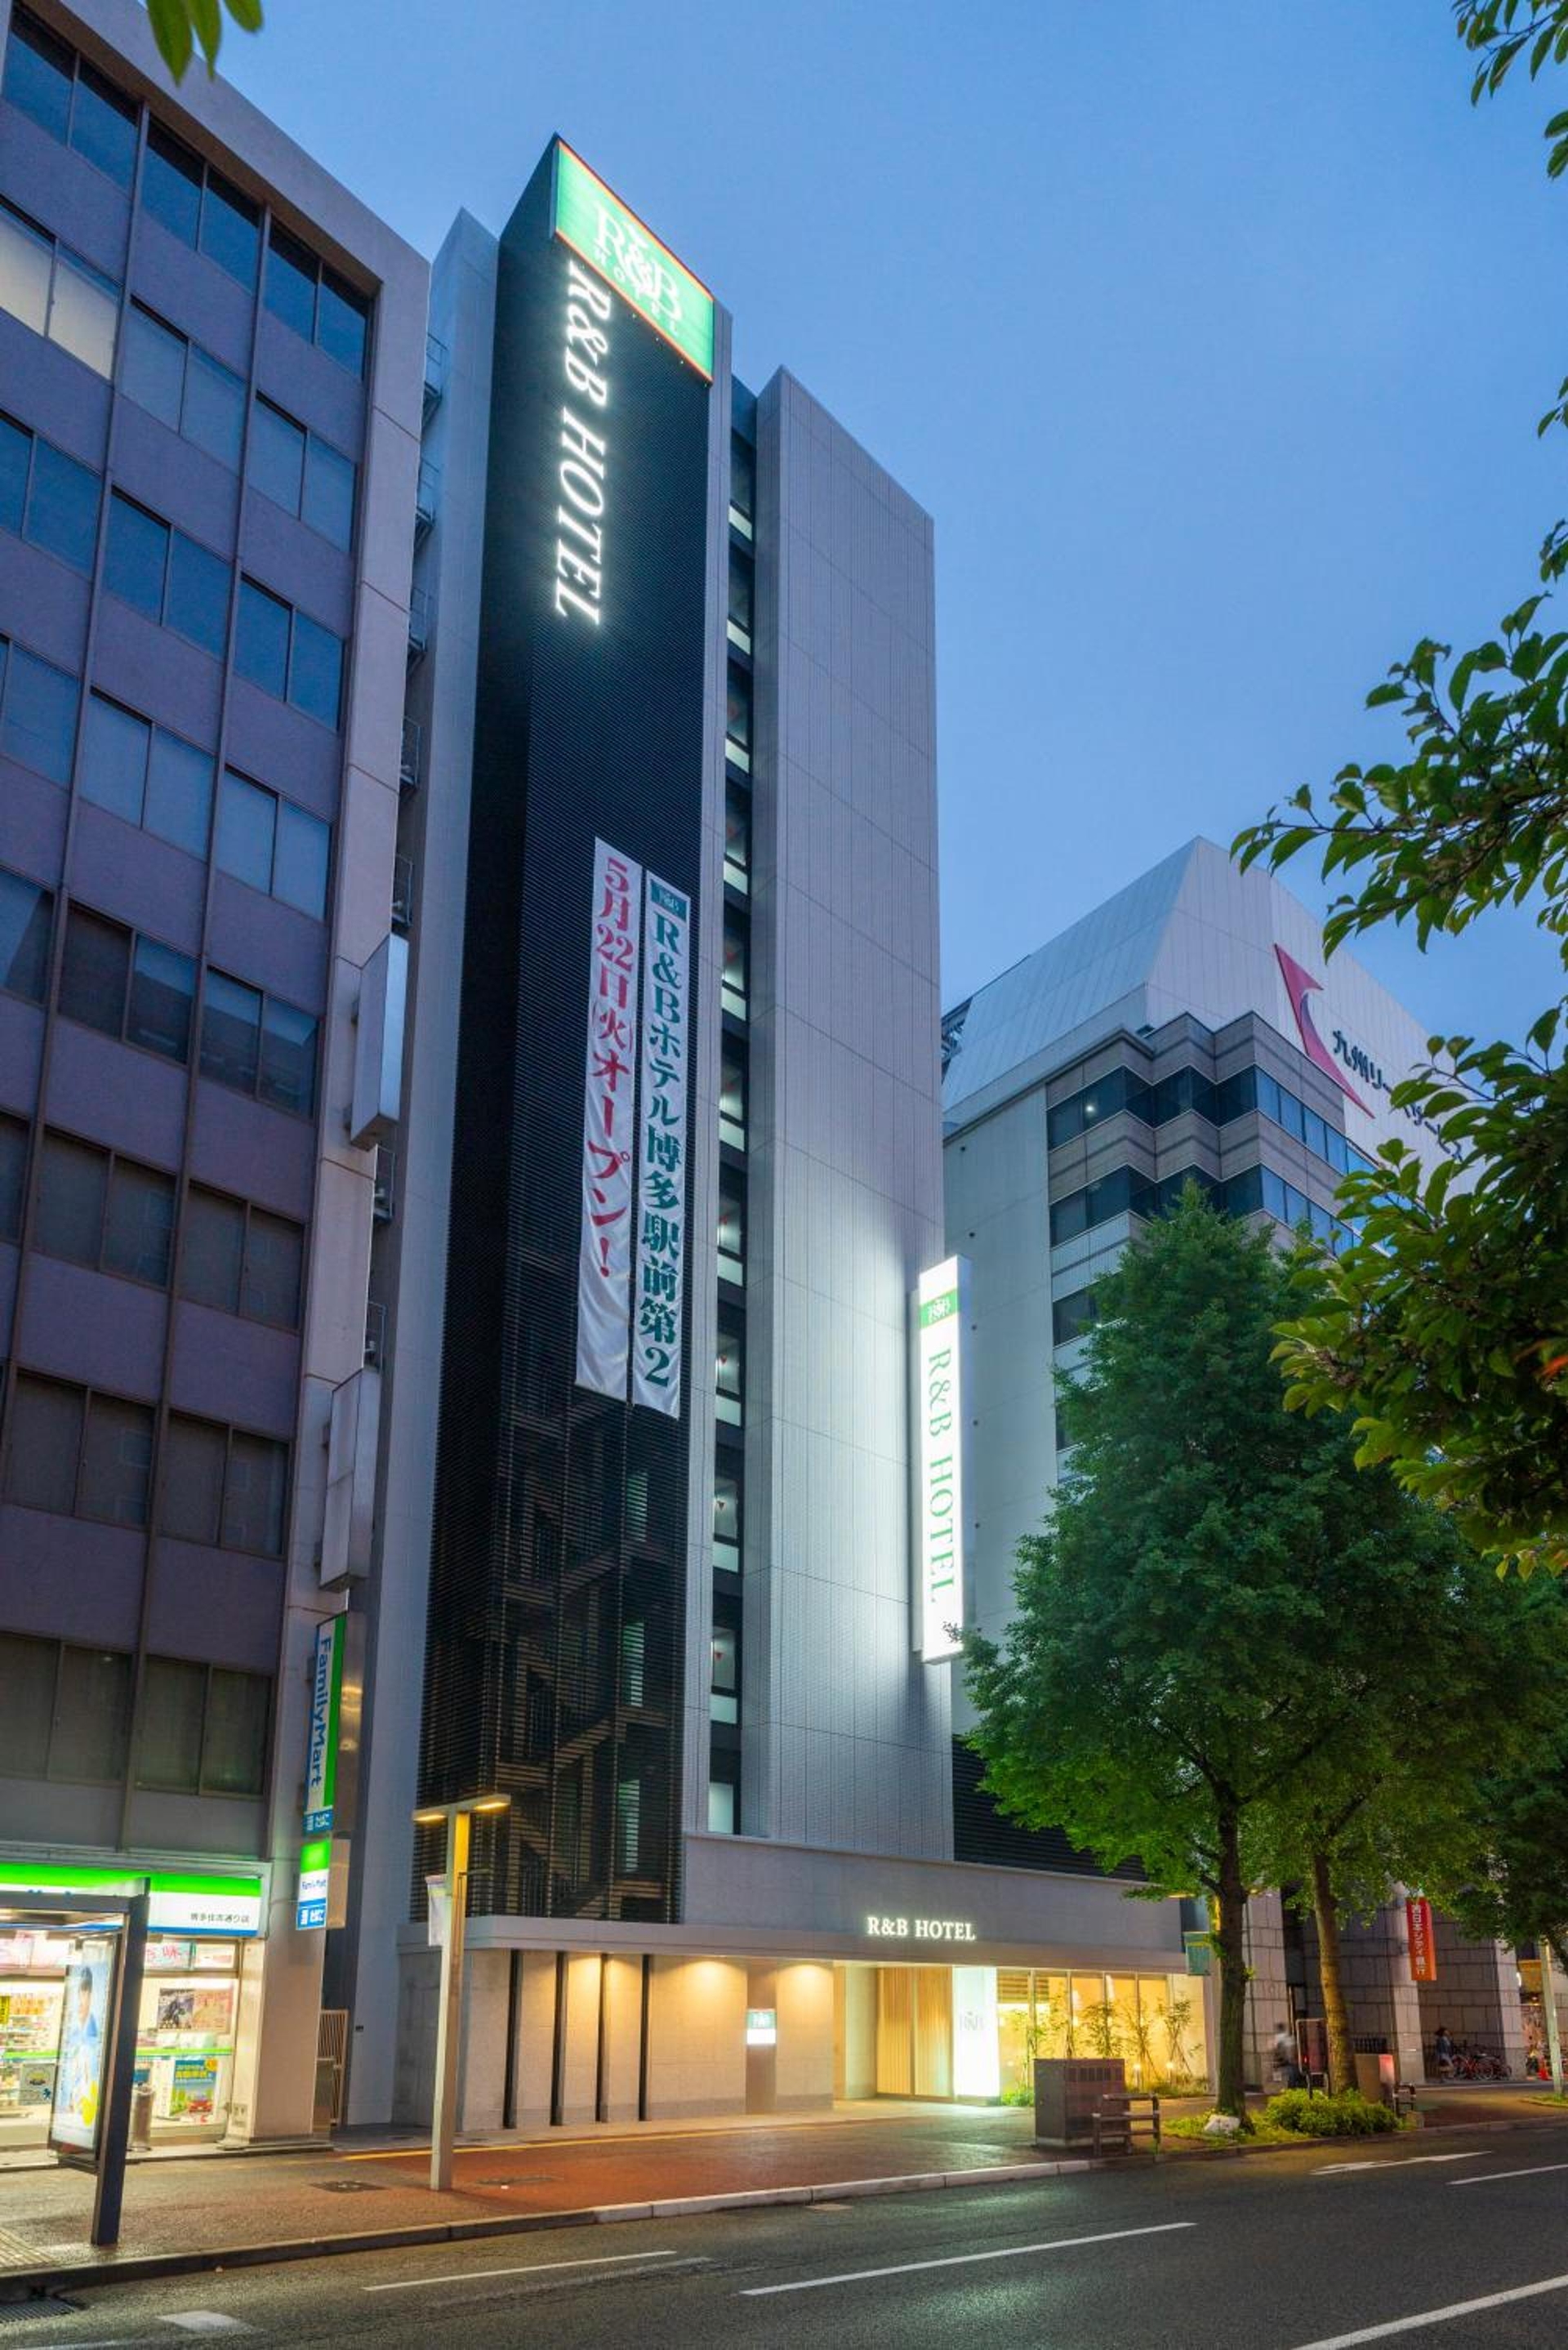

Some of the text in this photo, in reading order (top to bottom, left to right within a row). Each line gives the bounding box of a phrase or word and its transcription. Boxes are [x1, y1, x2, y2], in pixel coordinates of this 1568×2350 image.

[594, 201, 683, 320] R&B
[555, 259, 612, 626] R&B HOTEL
[639, 912, 681, 1387] R&Bホテル博多駅前第2
[929, 1348, 955, 1603] R&B HOTEL
[310, 1637, 332, 1788] FamilyMart
[867, 1916, 975, 1941] R&B HOTEL
